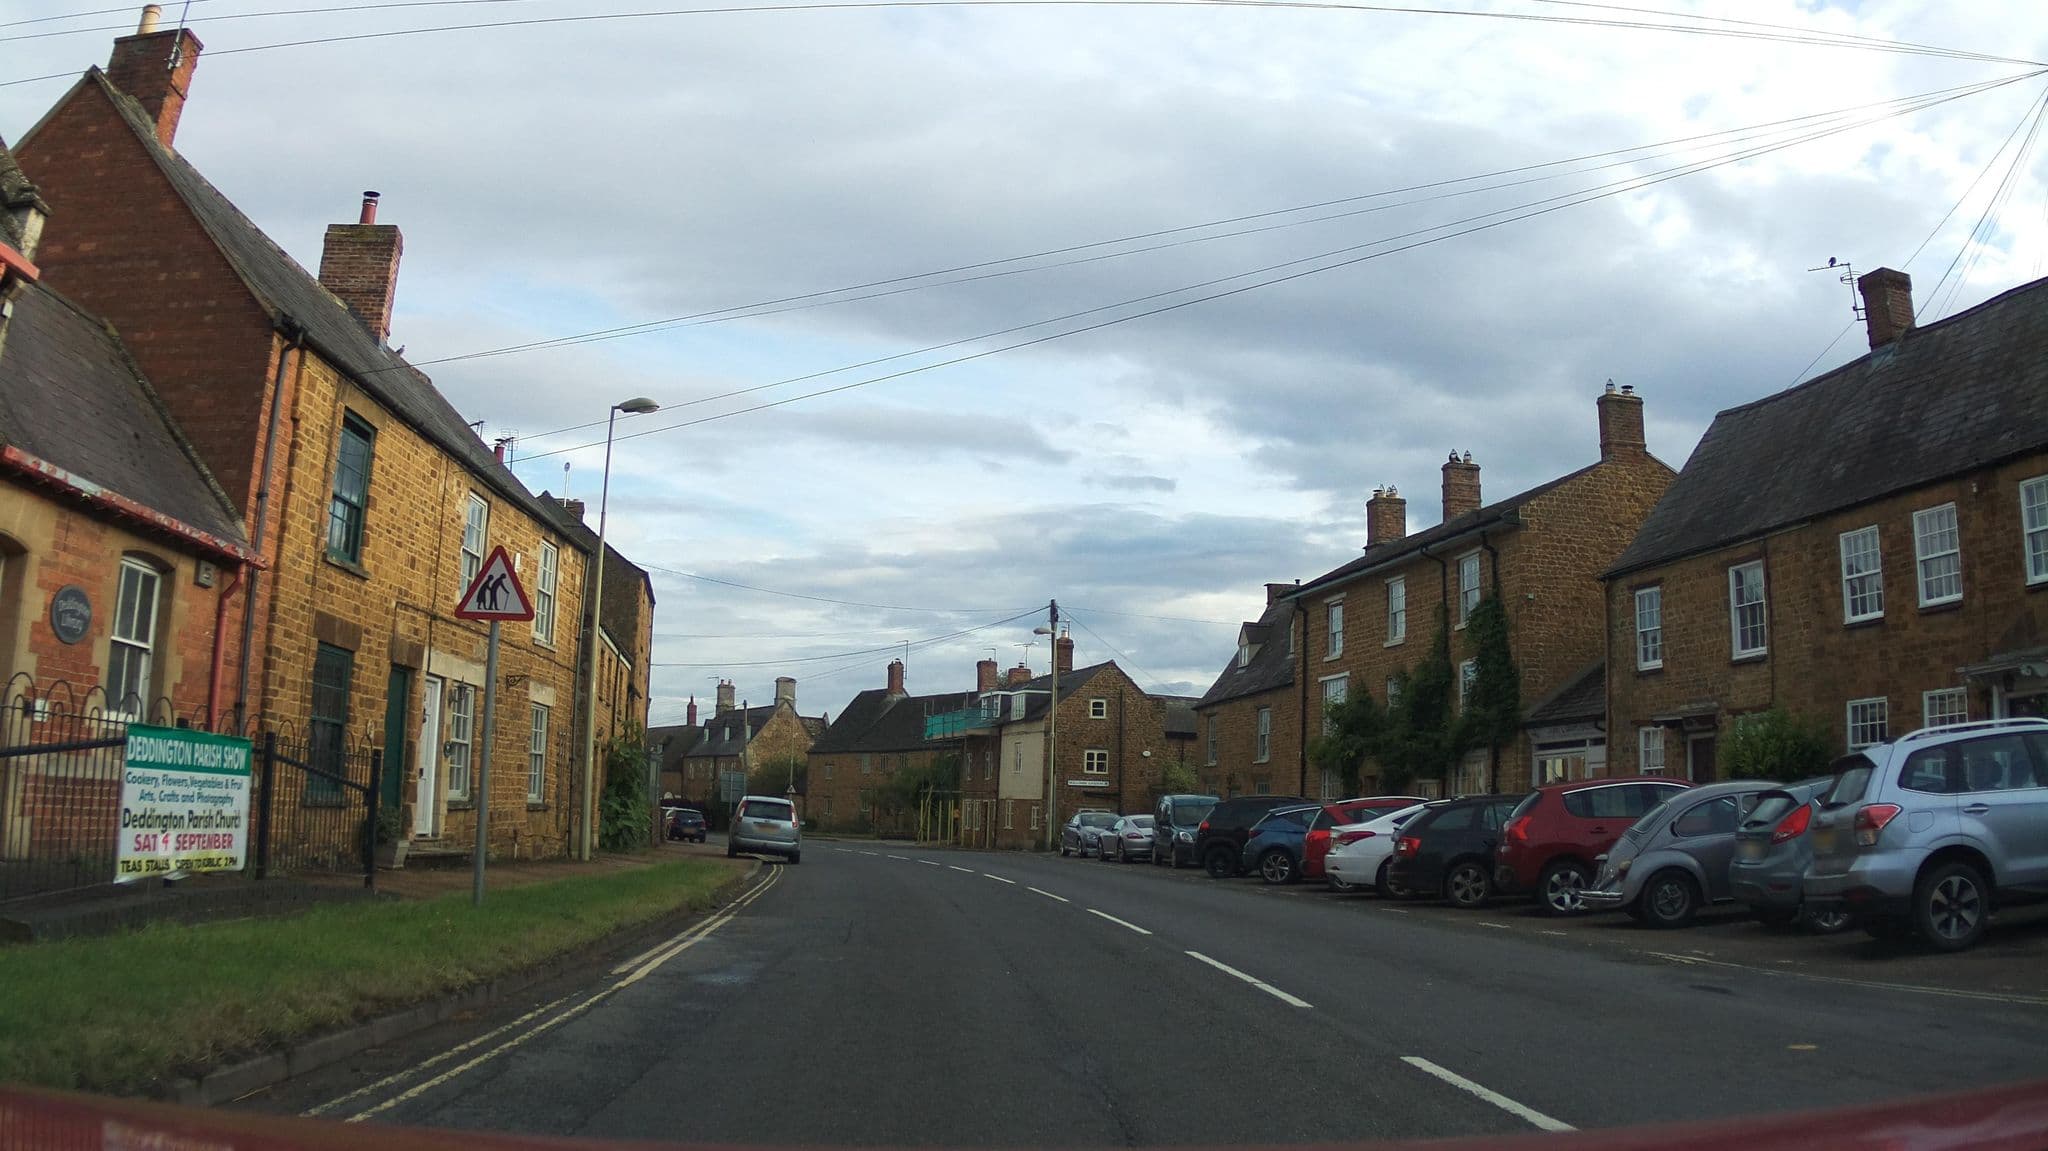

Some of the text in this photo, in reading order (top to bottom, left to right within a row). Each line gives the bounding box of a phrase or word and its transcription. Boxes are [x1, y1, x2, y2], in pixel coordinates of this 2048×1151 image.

[127, 735, 248, 770] DEDDINGTON PARISH SHOW
[125, 771, 160, 788] Cookery,
[159, 790, 180, 803] Crafts
[181, 791, 195, 803] and
[196, 792, 234, 807] Photography
[122, 808, 185, 833] Deddington
[187, 809, 213, 829] Parish
[133, 833, 158, 852] SAT
[175, 833, 233, 851] SEPTEMBER
[120, 860, 142, 873] TEAS
[145, 858, 170, 872] STALLS
[175, 859, 193, 870] OPEN
